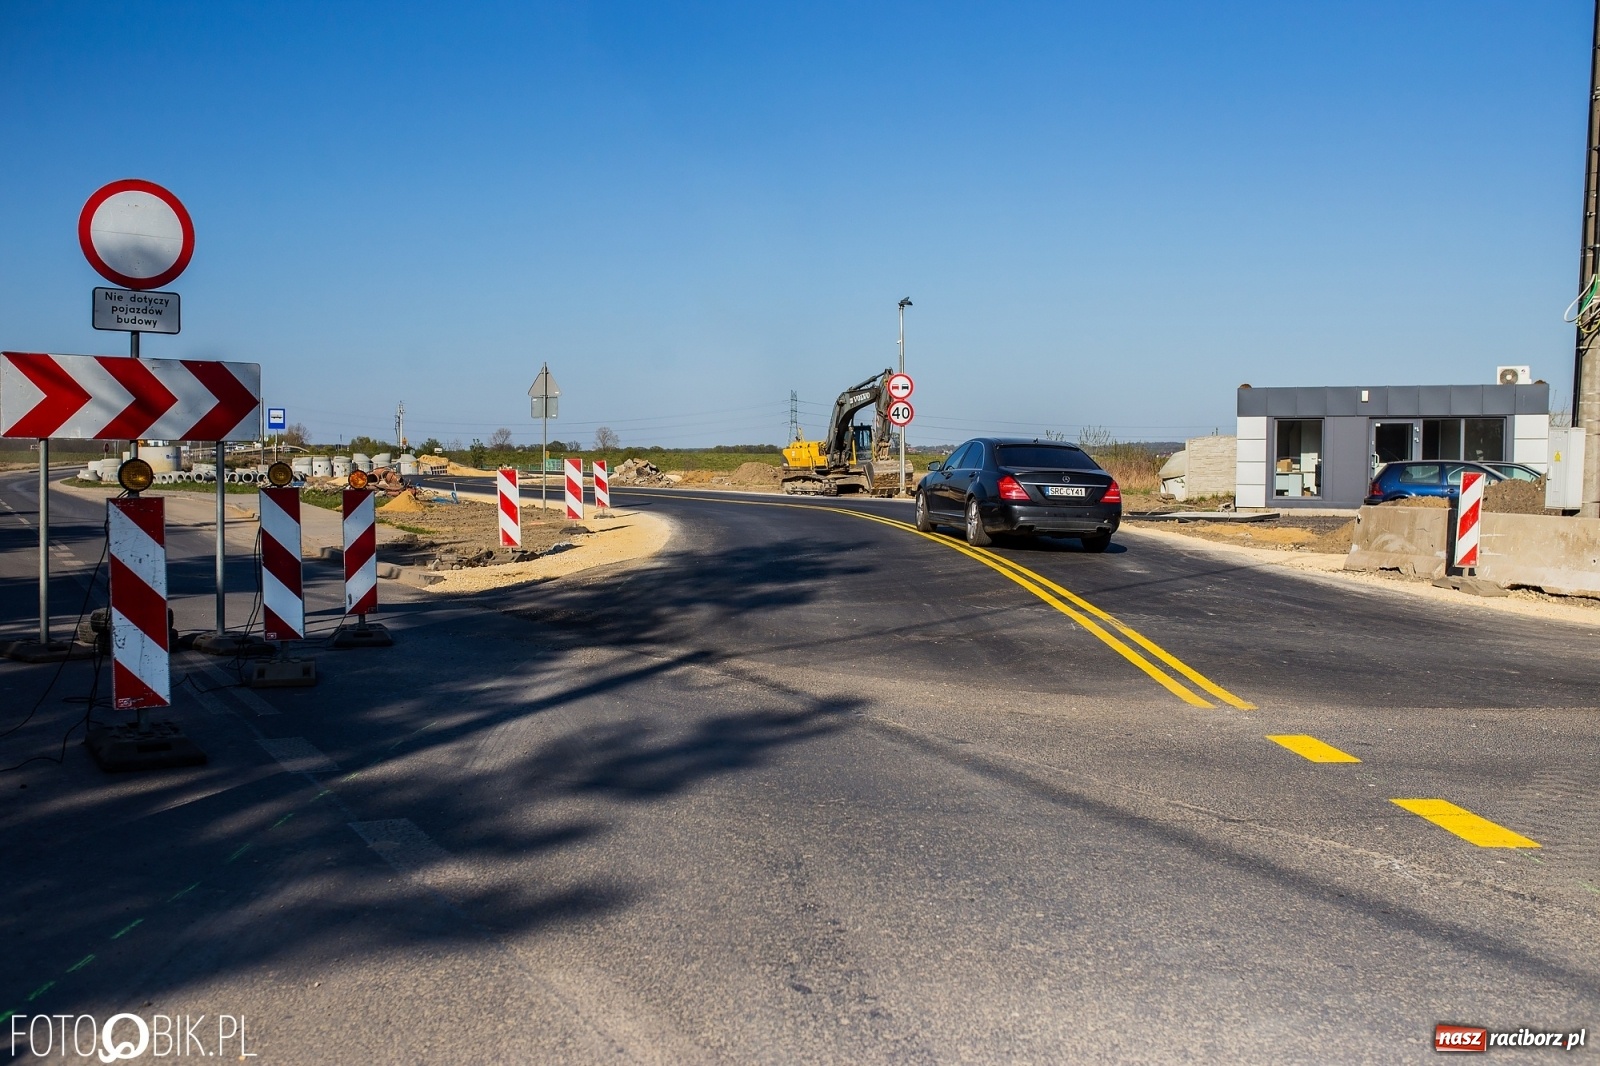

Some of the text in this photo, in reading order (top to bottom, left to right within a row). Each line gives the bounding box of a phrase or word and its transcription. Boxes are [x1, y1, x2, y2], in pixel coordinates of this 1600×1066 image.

[105, 292, 170, 307] Nie dotyczy
[111, 305, 163, 315] pojazdów
[116, 315, 158, 328] budowy
[891, 407, 910, 420] 40
[1050, 487, 1083, 496] SRC CY41
